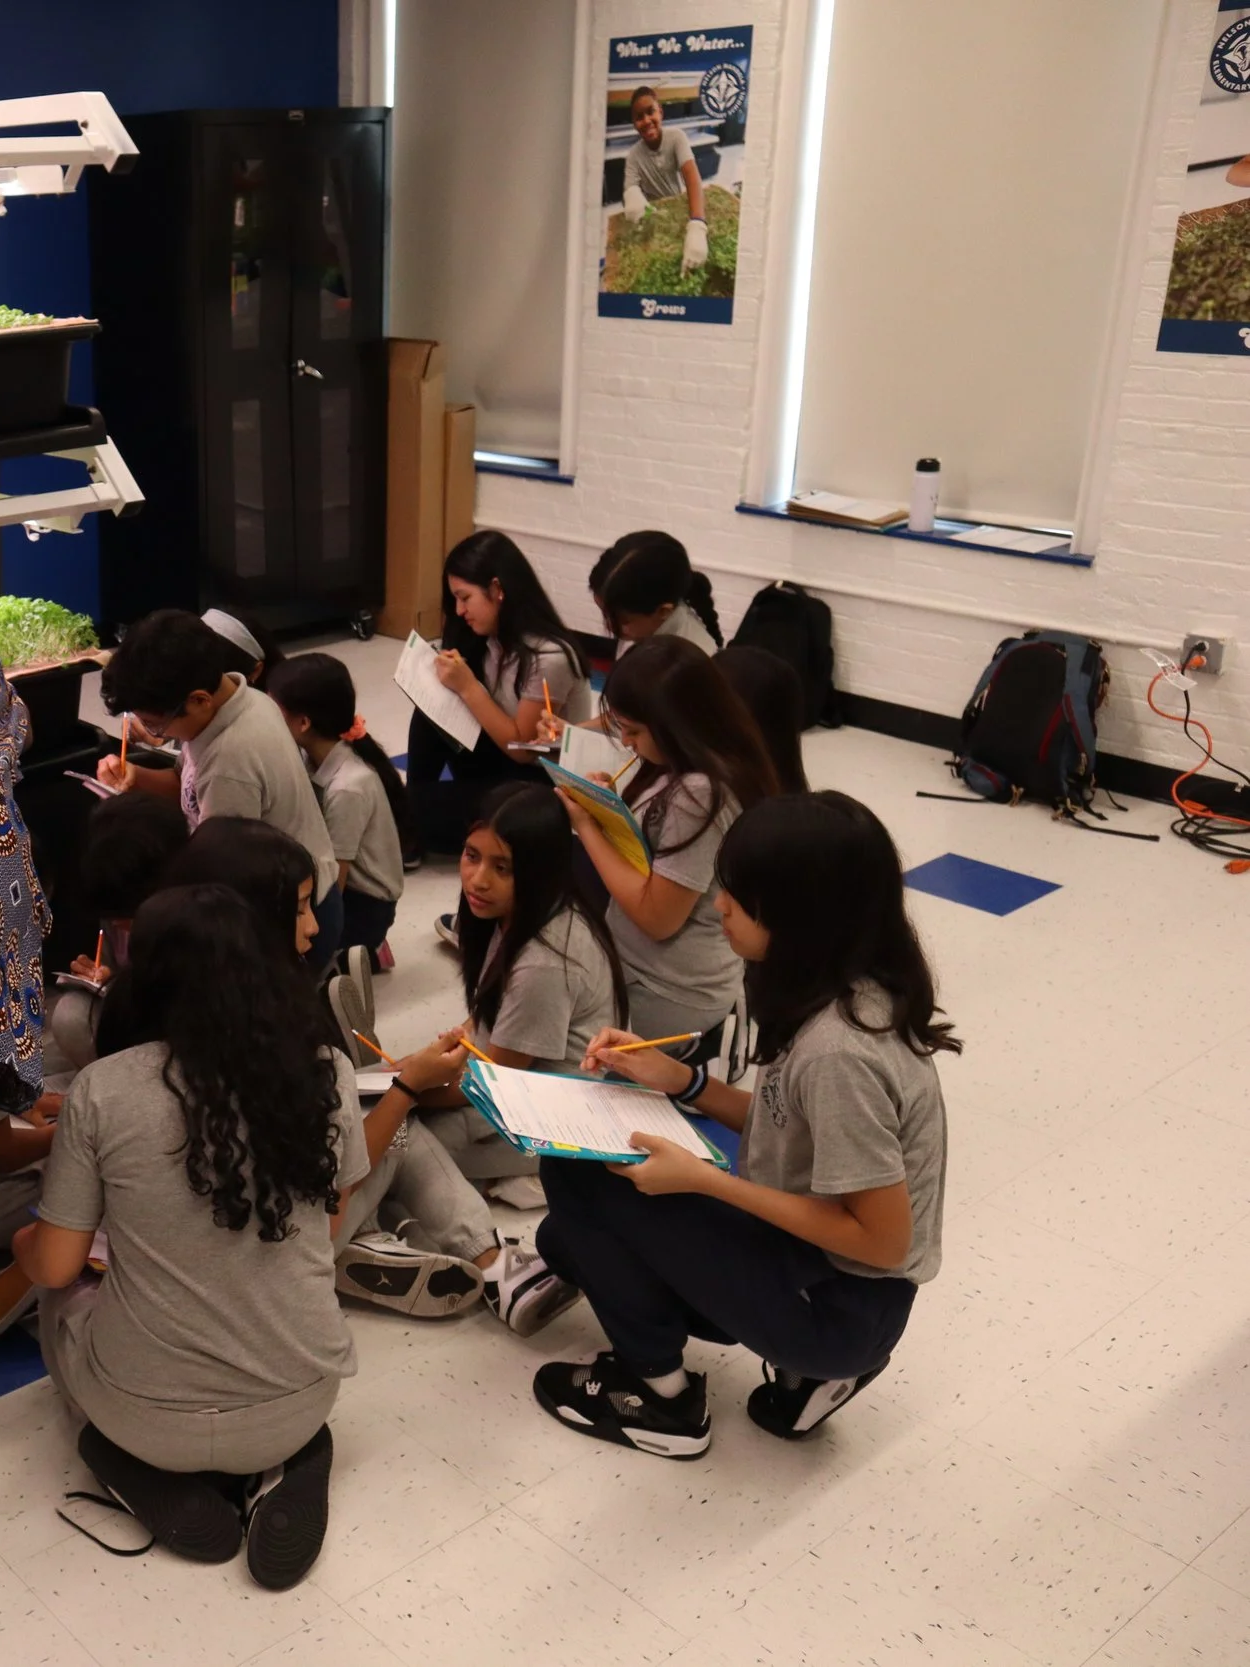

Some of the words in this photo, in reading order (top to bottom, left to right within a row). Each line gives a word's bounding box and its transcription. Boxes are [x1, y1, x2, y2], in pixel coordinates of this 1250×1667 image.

[616, 41, 653, 57] What
[657, 37, 682, 54] We
[640, 298, 686, 317] Grows
